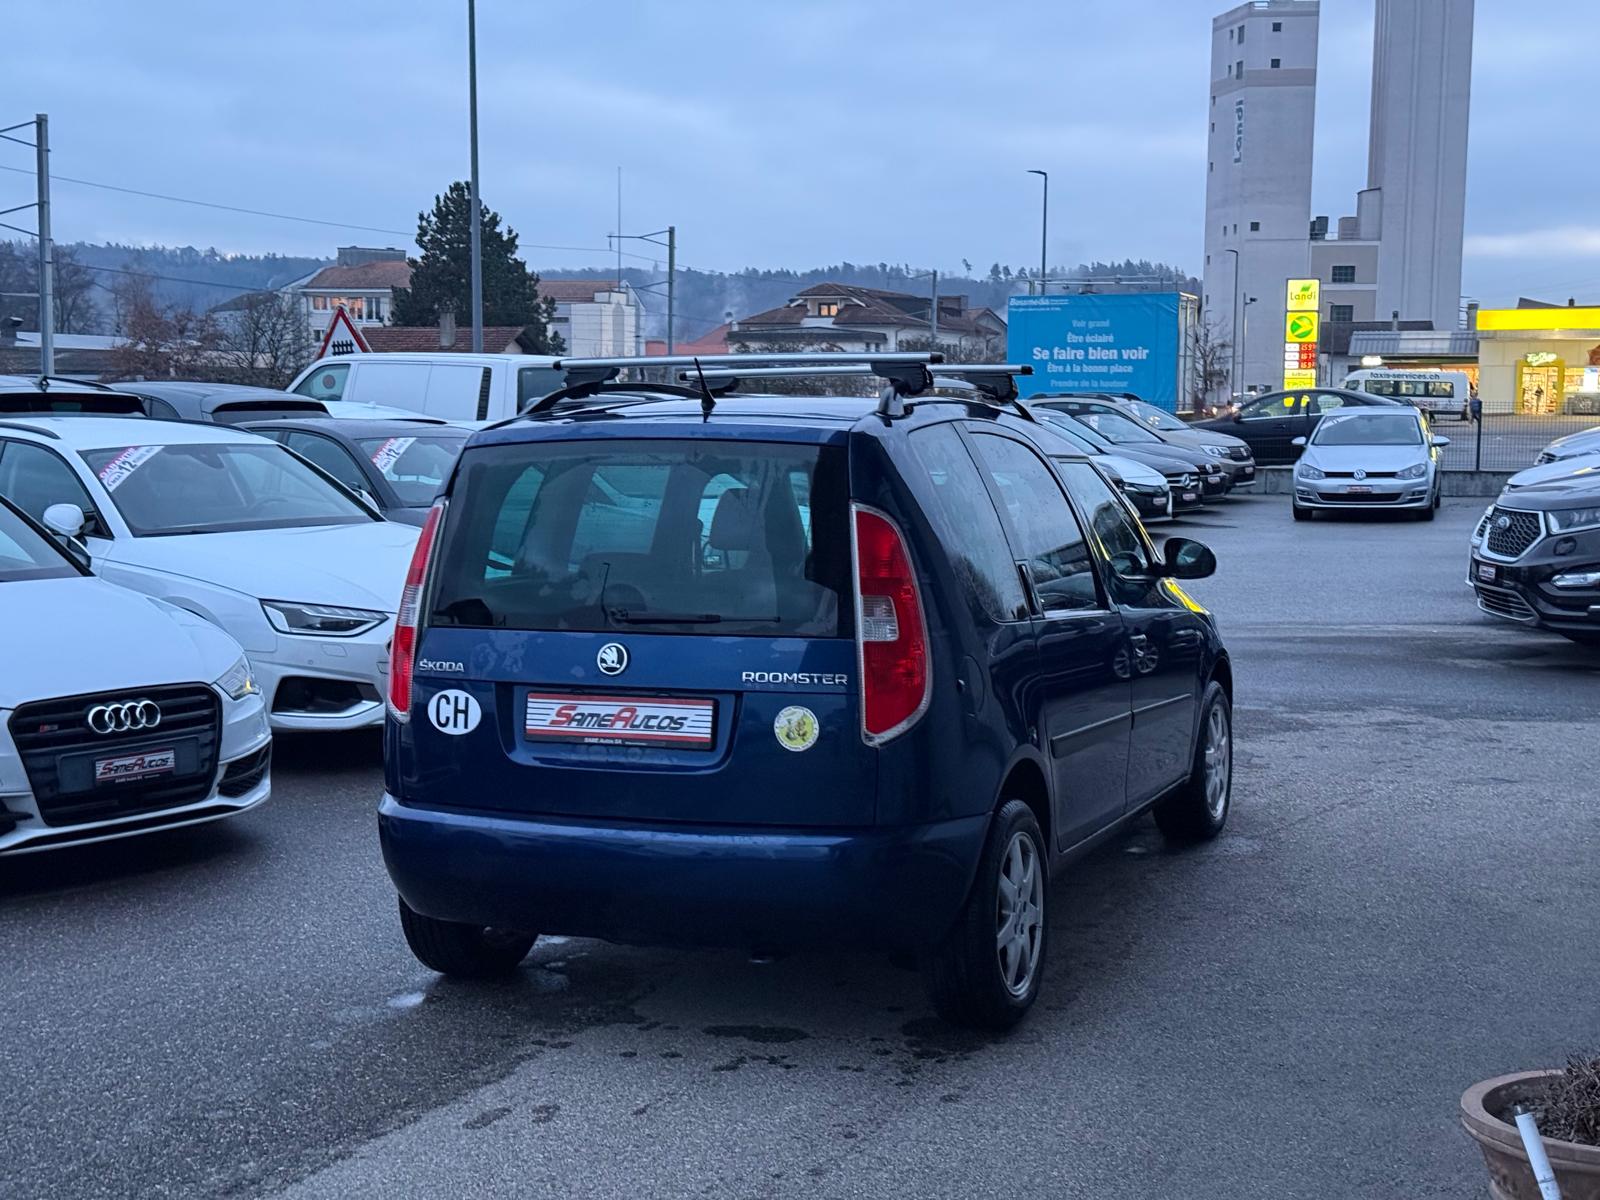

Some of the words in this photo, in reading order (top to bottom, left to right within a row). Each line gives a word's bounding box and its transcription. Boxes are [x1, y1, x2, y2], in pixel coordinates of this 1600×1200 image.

[1234, 100, 1244, 163] Landi
[1290, 291, 1316, 301] Landi
[1067, 332, 1084, 343] Être
[1085, 333, 1114, 343] éclairé
[1033, 347, 1050, 360] Se
[1053, 346, 1085, 360] faire
[1088, 346, 1118, 360] bien
[1121, 347, 1149, 360] voir
[1047, 361, 1064, 373] Être
[1072, 363, 1081, 373] la
[1110, 363, 1133, 374] place
[1370, 372, 1440, 380] taxis-services.ch
[118, 460, 137, 472] 12
[419, 658, 465, 673] ŠKODA
[742, 671, 848, 685] ROOMSTER
[436, 694, 470, 730] CH
